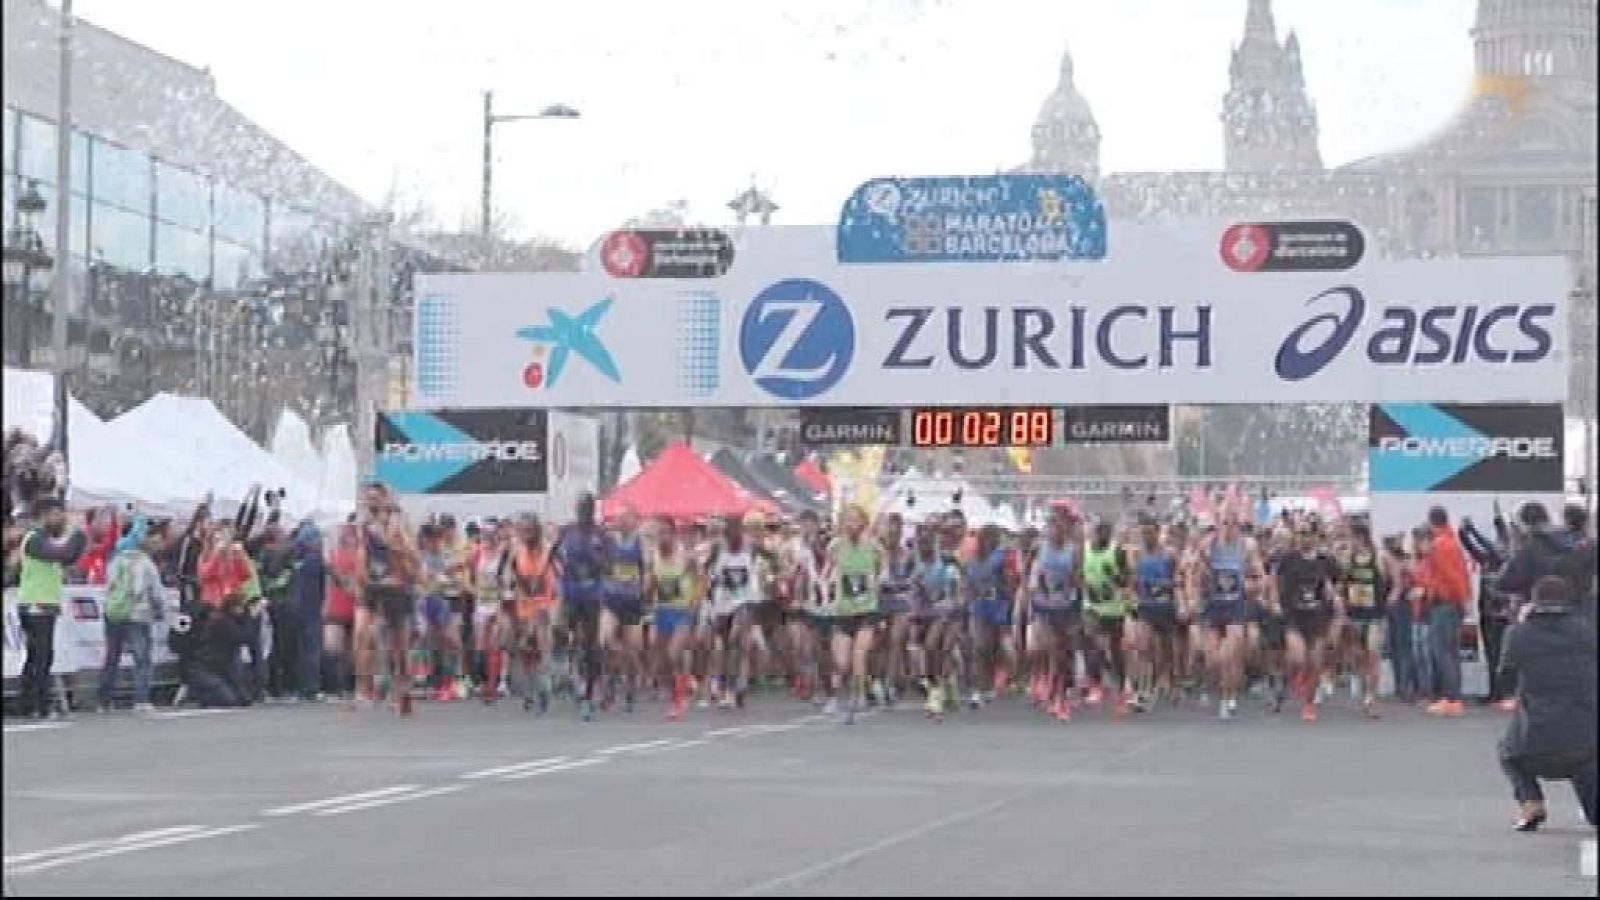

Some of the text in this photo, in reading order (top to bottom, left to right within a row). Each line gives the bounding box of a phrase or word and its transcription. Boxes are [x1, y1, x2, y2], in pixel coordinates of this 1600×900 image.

[881, 305, 1212, 369] ZURICH
[804, 423, 893, 440] GARMIN
[915, 411, 952, 444] 00
[963, 411, 1000, 444] 02
[1071, 422, 1160, 438] GARMIN
[383, 441, 540, 461] POWERADE
[1379, 437, 1556, 457] POWERADE
